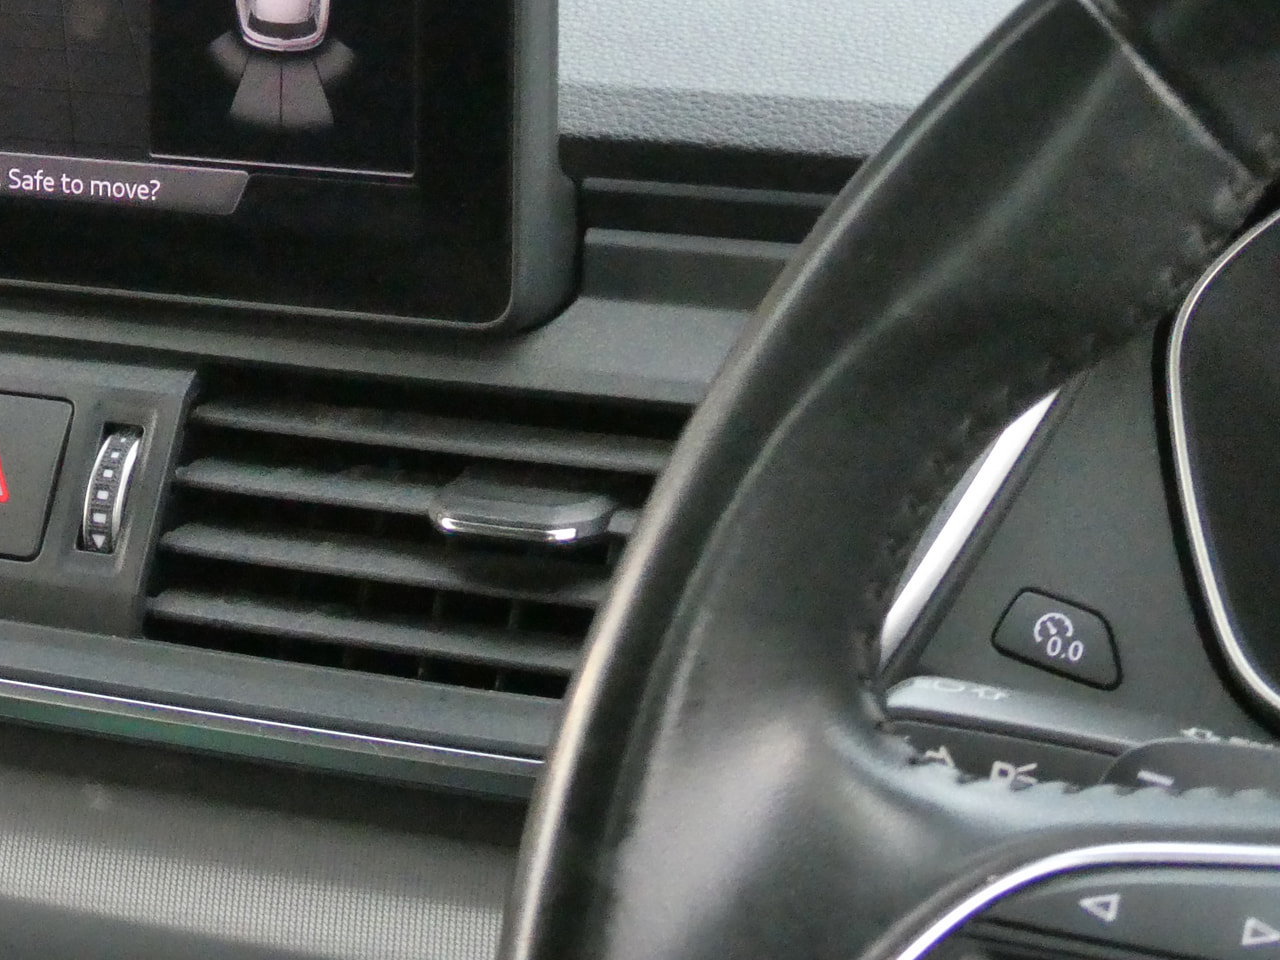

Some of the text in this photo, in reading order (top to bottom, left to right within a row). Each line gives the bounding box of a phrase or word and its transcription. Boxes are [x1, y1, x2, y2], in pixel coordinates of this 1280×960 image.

[8, 167, 55, 193] Safe
[60, 173, 84, 194] to
[90, 178, 161, 201] move?
